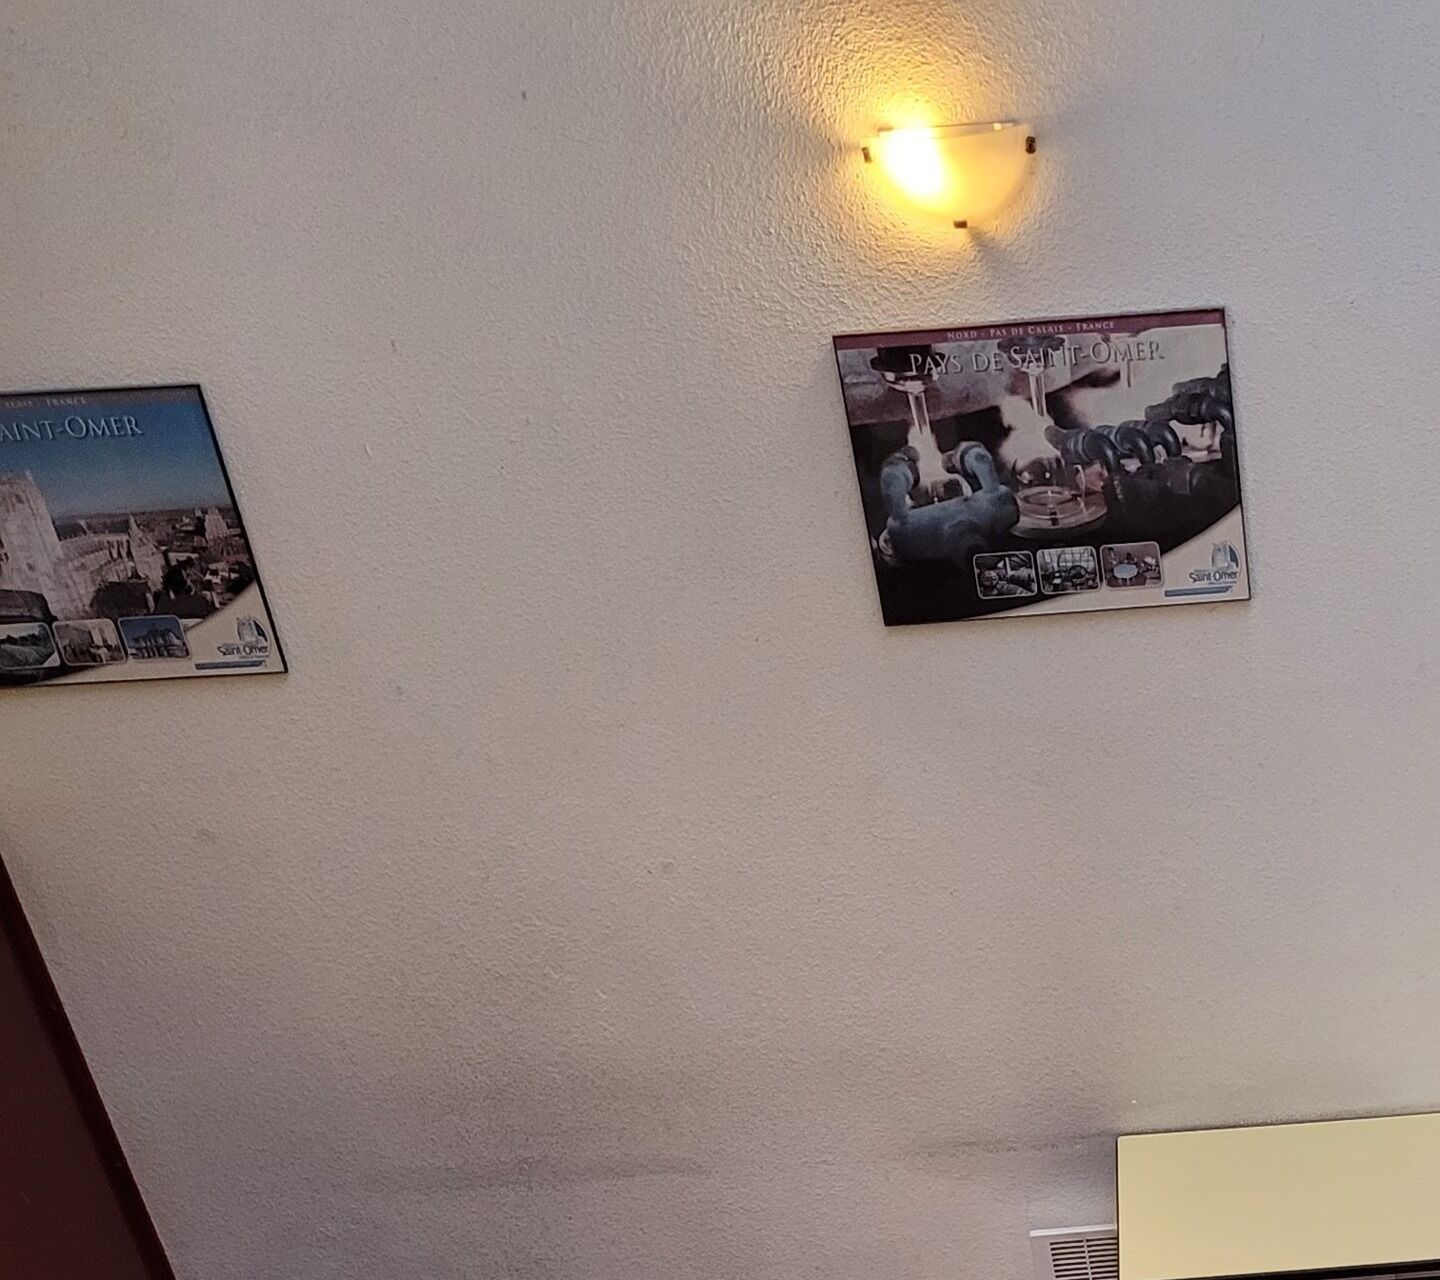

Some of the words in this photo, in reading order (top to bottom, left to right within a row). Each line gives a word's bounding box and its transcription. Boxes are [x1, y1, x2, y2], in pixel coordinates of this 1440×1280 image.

[947, 330, 977, 340] NORD
[990, 328, 1008, 337] PAS
[1011, 327, 1023, 336] DE
[1028, 325, 1064, 335] CALAIS
[909, 352, 964, 376] PAYS
[972, 351, 1002, 373] DE
[1009, 340, 1166, 370] SAINT-OMER
